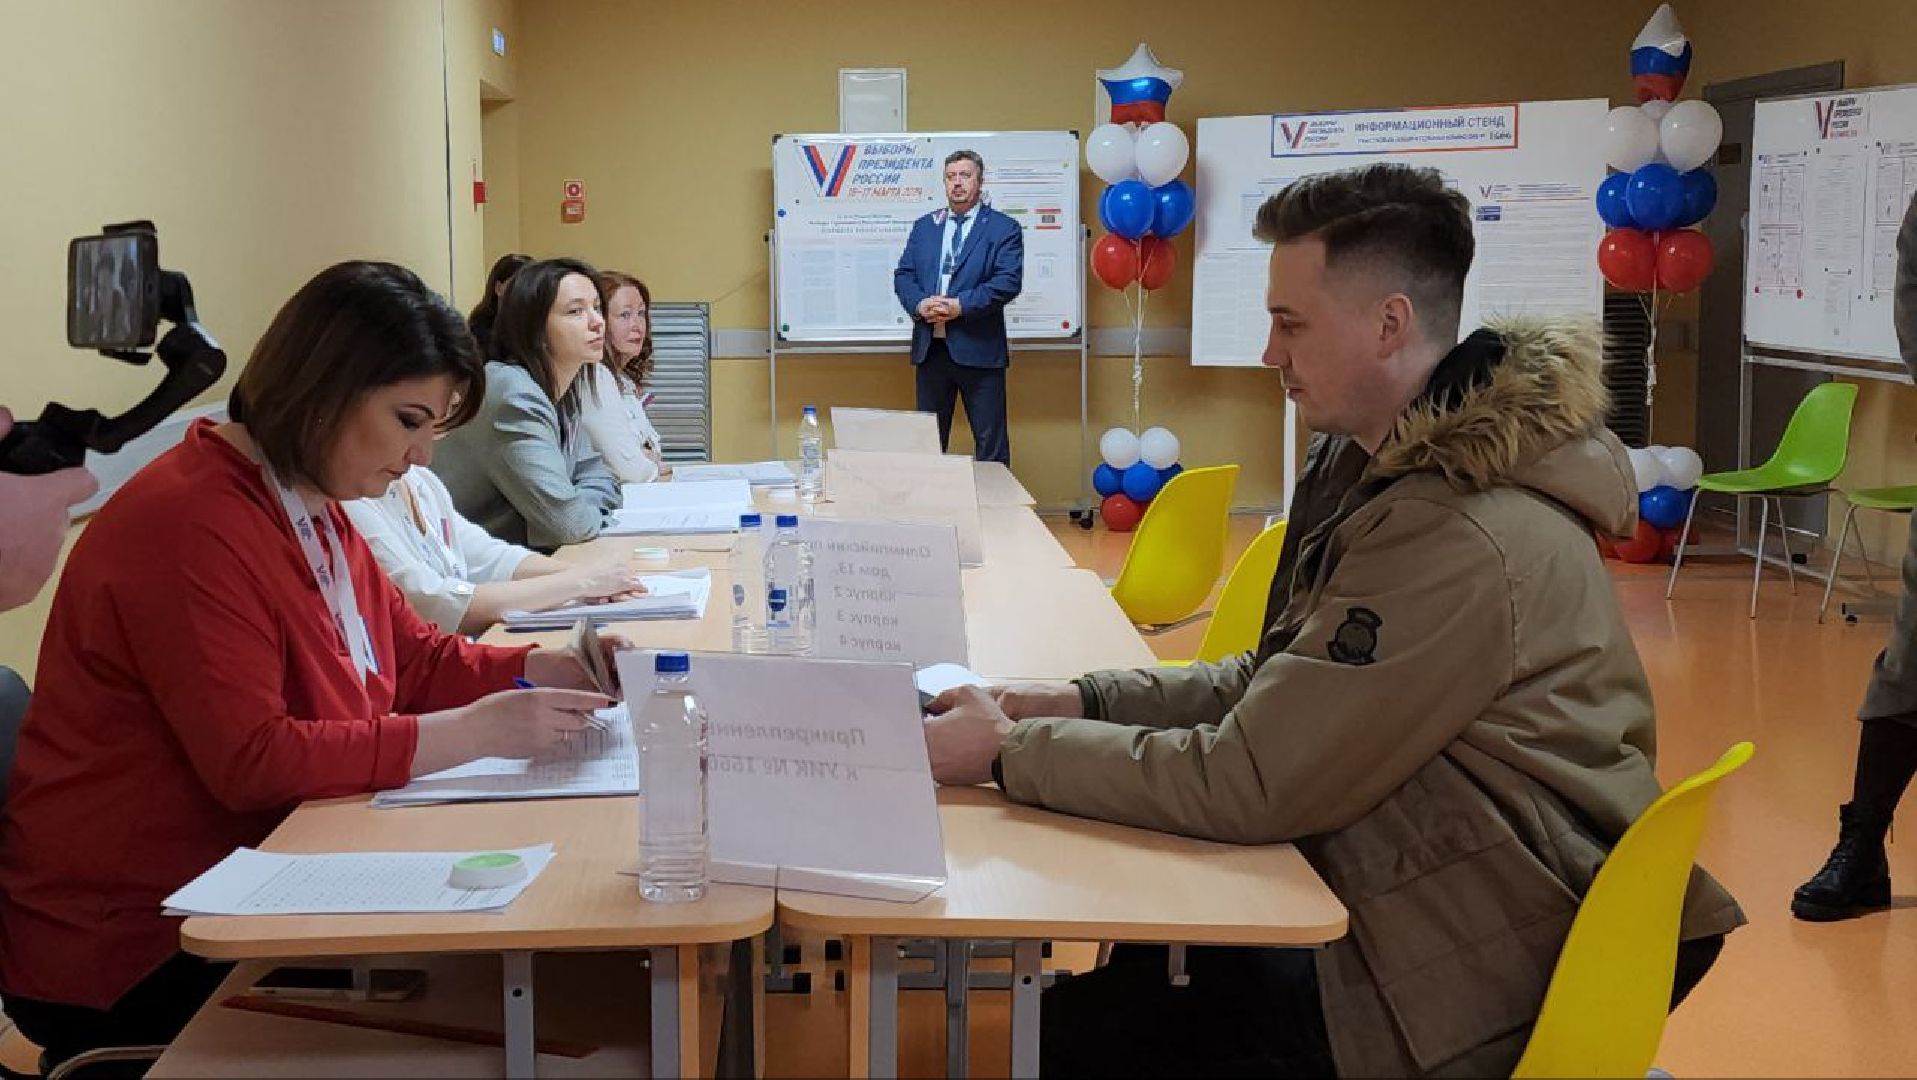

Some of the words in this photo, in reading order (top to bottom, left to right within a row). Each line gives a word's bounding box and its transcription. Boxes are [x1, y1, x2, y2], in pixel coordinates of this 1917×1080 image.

[1355, 116, 1465, 132] ИНФОРМАЦИОННЫЙ
[1468, 115, 1506, 128] СТЕНД
[863, 144, 917, 155] ВЫБОРЫ
[858, 157, 934, 170] ПРЕЗИДЕНТА
[851, 174, 901, 185] РОССИИ
